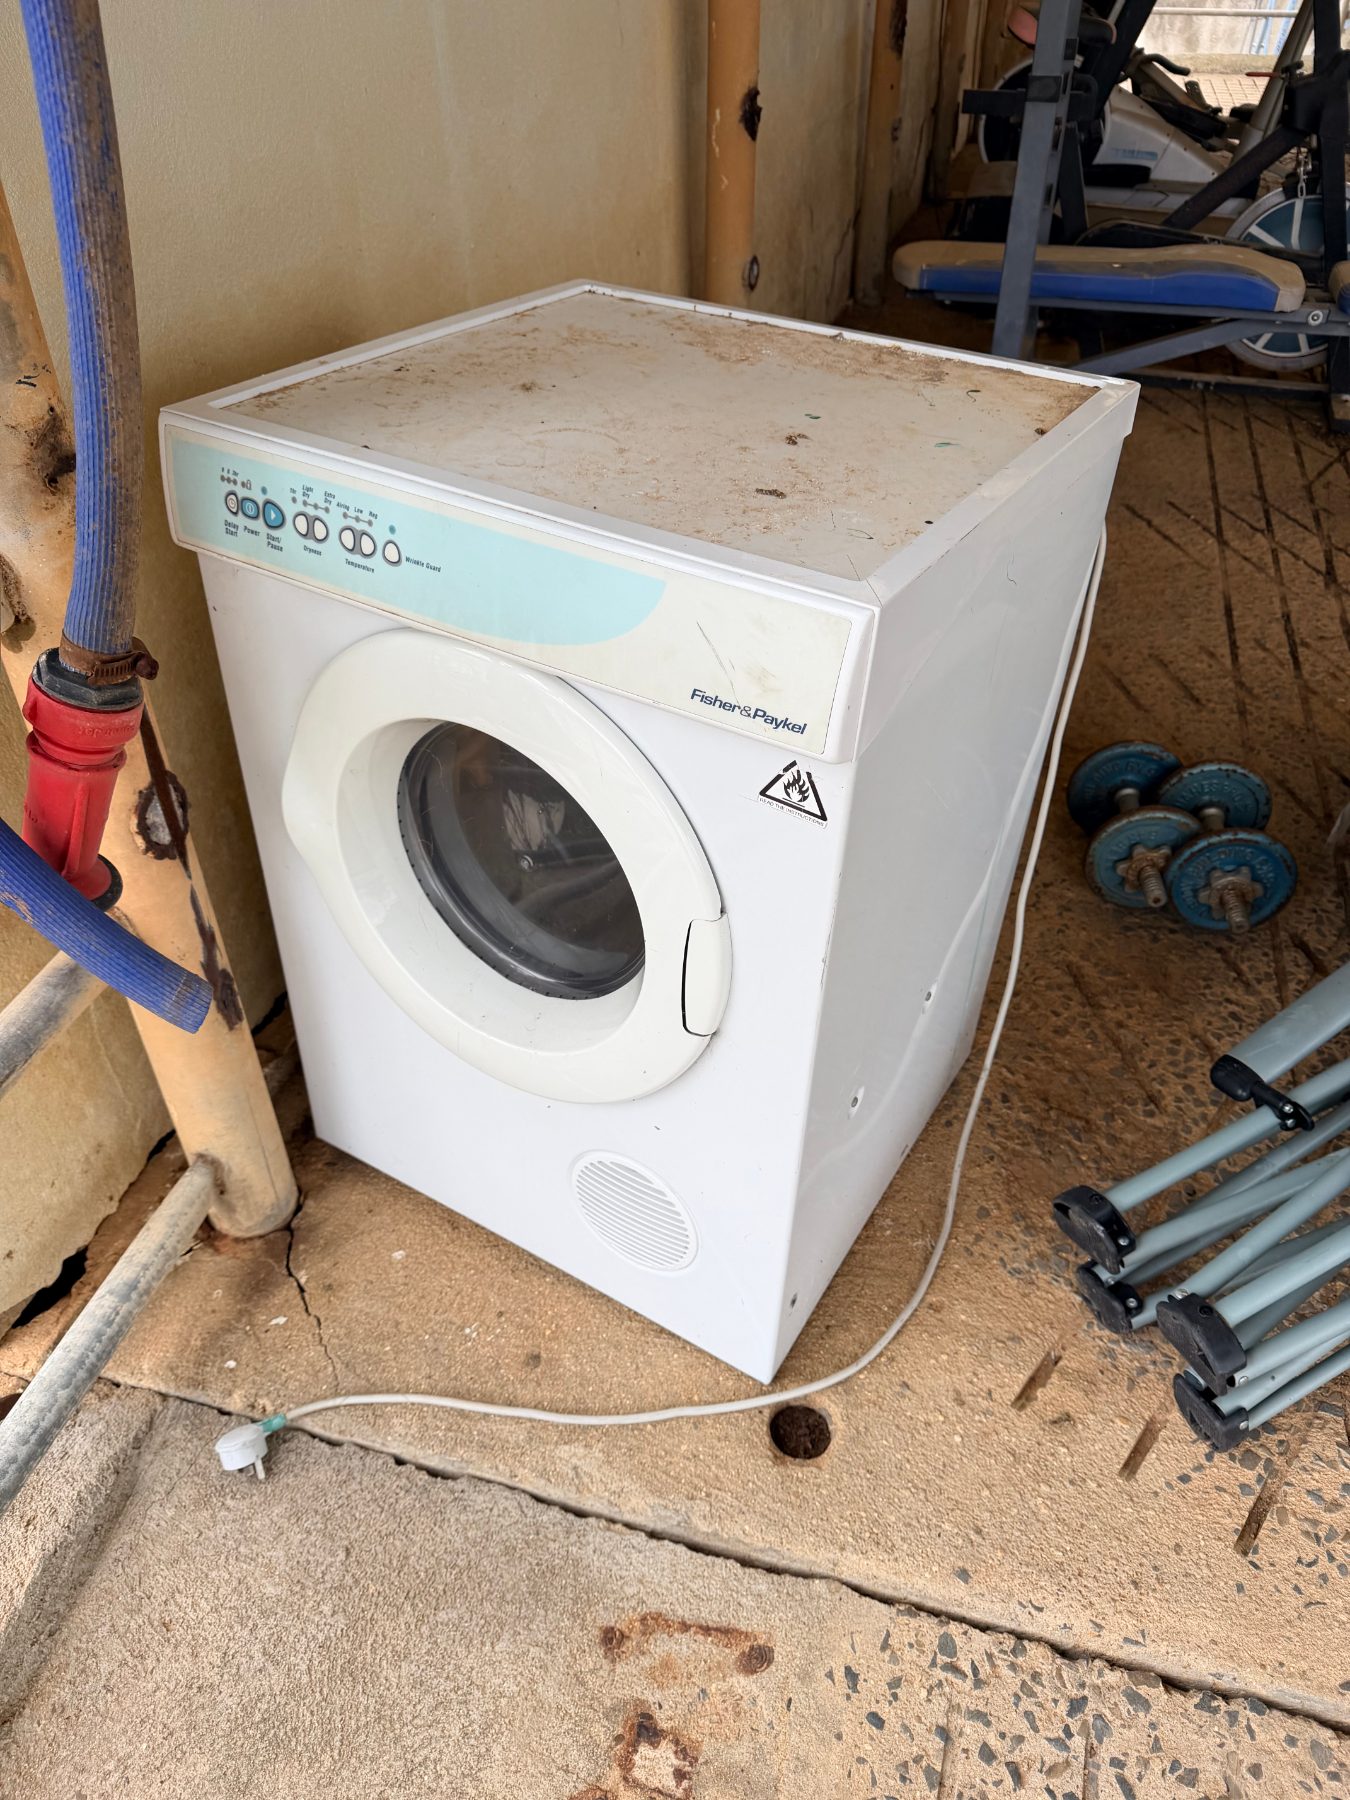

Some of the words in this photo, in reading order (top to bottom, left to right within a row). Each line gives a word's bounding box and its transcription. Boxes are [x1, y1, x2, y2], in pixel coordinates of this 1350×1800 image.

[302, 484, 314, 493] Light
[302, 491, 310, 499] Dry
[324, 490, 336, 500] Extra
[324, 497, 332, 506] Dry
[336, 501, 350, 512] Airing
[354, 506, 364, 514] Low
[224, 519, 239, 532] Delay
[243, 525, 261, 537] Power
[225, 527, 238, 537] Start
[266, 532, 282, 544] Start/
[266, 540, 284, 552] Pause
[303, 545, 322, 556] Dryness
[345, 558, 375, 573] Temperature
[405, 555, 424, 568] Wrinkle
[425, 563, 442, 573] Guard
[759, 797, 775, 807] READ
[775, 803, 785, 811] THE
[786, 807, 825, 827] INSTRUCTIONS
